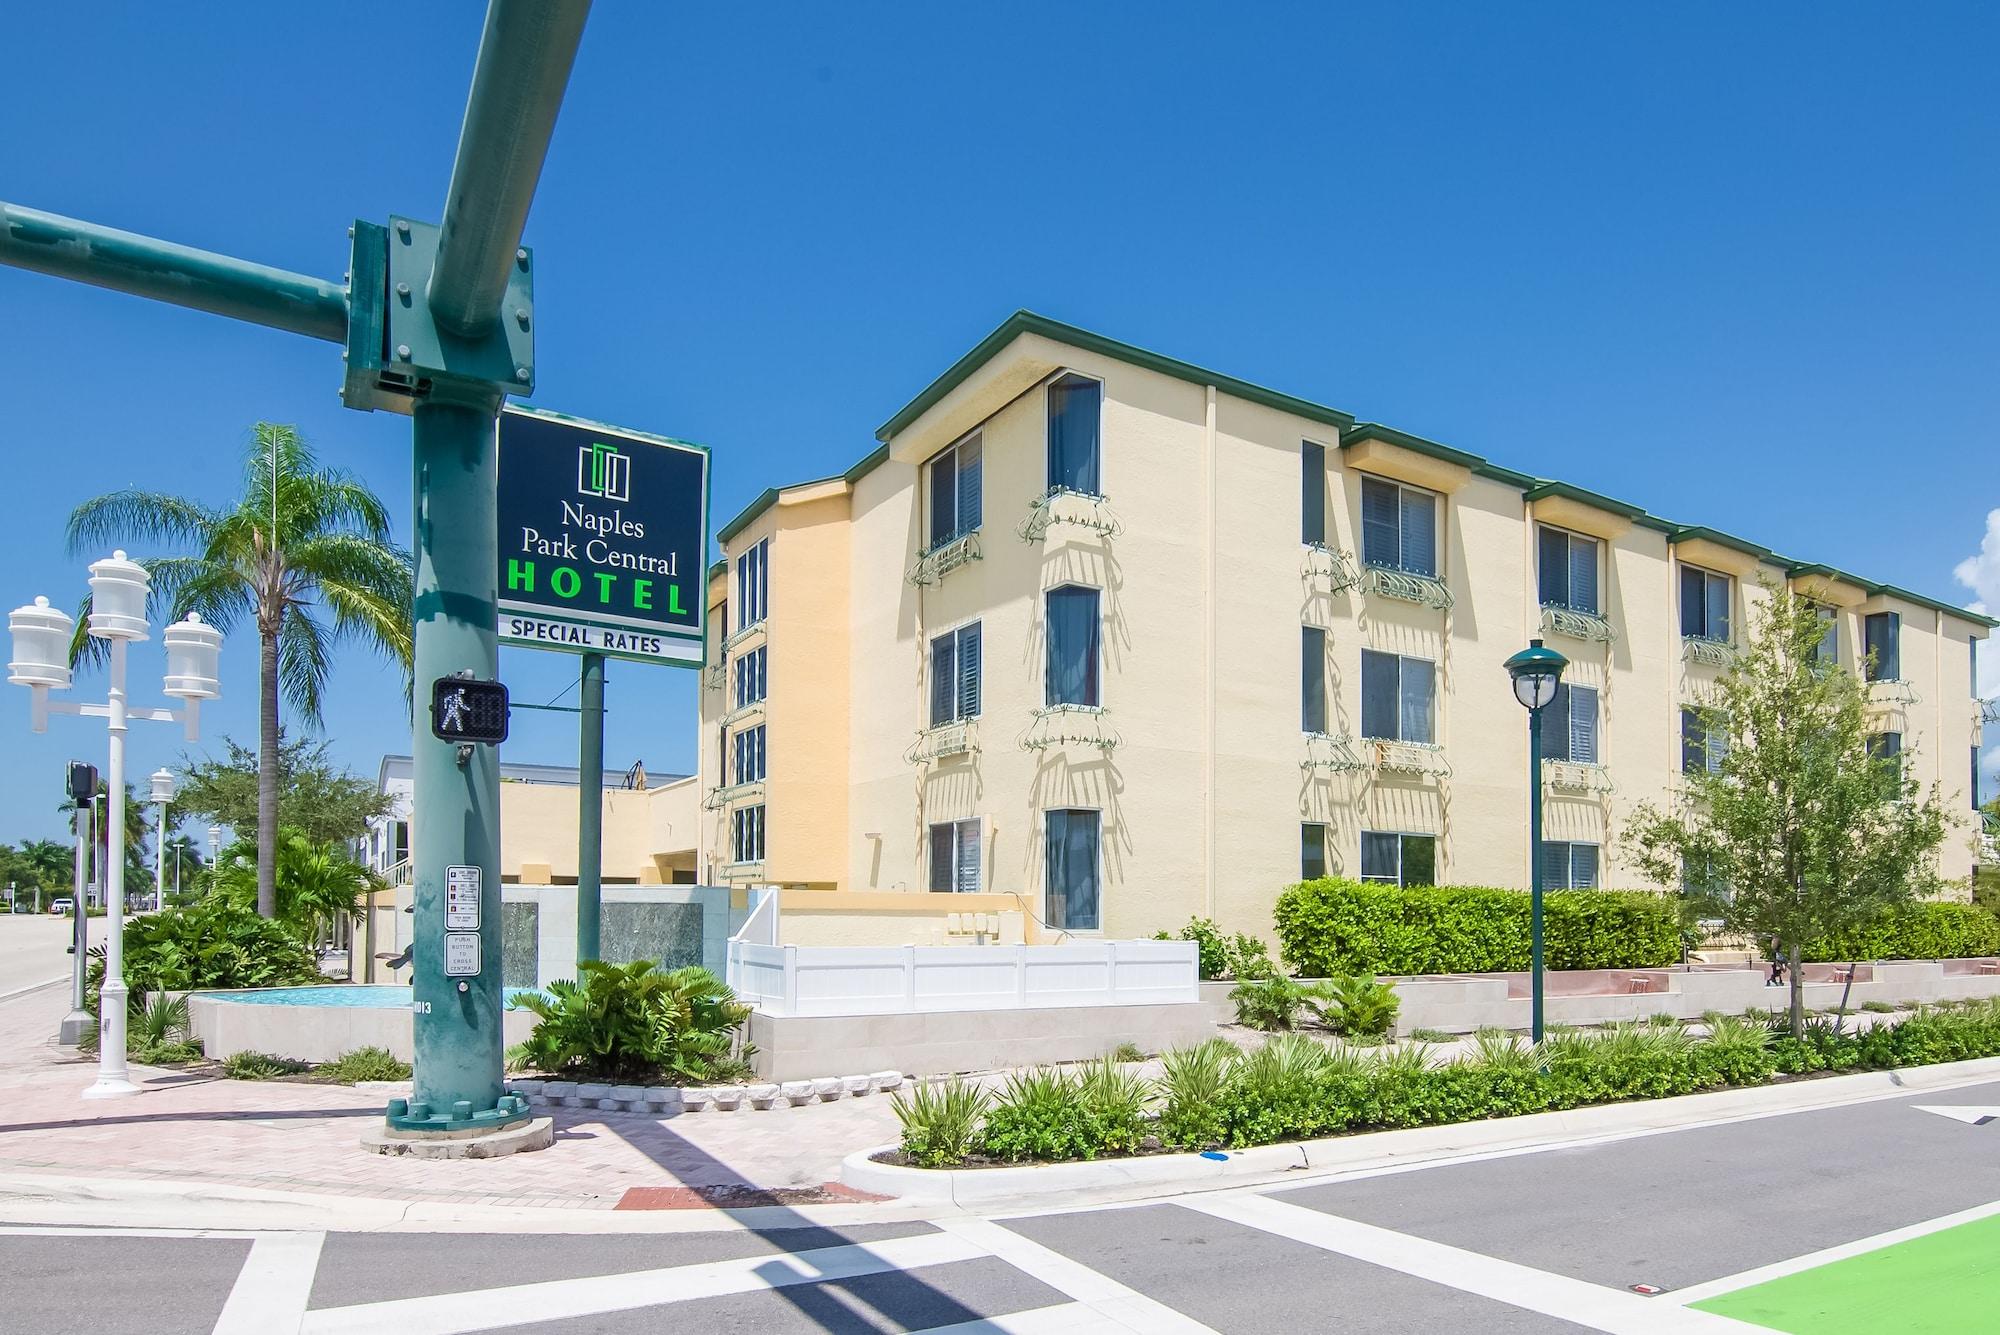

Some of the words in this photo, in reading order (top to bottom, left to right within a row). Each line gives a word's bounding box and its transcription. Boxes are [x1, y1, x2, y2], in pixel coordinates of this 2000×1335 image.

[561, 500, 645, 538] Naples
[521, 527, 579, 560] Park
[585, 539, 678, 577] Central
[507, 559, 688, 615] HOTEL
[510, 619, 592, 645] SPECIAL
[603, 632, 661, 654] RATES
